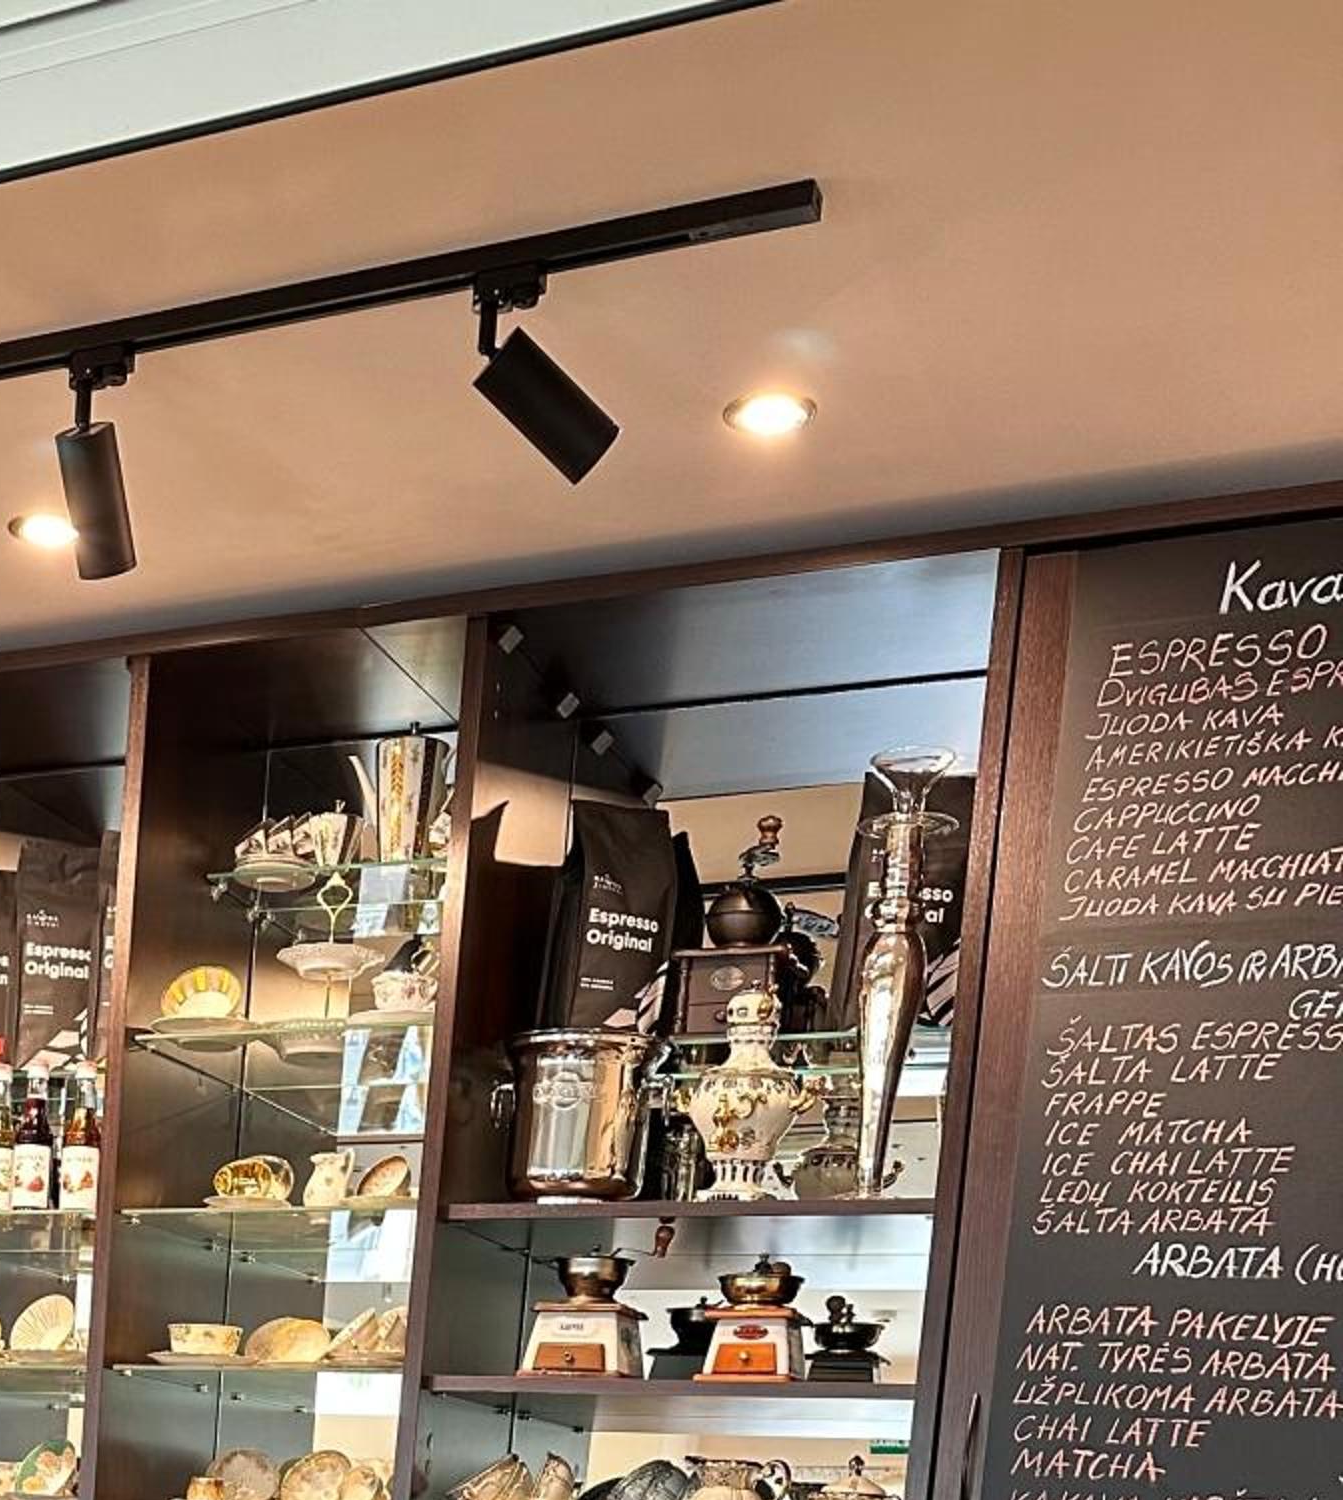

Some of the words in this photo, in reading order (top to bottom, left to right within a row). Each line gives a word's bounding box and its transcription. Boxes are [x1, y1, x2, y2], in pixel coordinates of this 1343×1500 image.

[1108, 624, 1327, 678] ESPRESSO
[1085, 711, 1194, 740] JUODA
[1203, 703, 1284, 730] KAVA
[1085, 727, 1312, 772] AMERIKIETIŠKA
[1082, 768, 1233, 803] ESPRESSO
[1073, 795, 1261, 833] CAPPUCCINO
[1066, 834, 1145, 865] CAFE
[1152, 823, 1262, 855] LATTE
[1064, 858, 1198, 894] CARAMEL
[588, 907, 659, 934] Espresso
[1059, 895, 1159, 921] JUODA
[1168, 890, 1237, 917] KAVA
[1246, 885, 1287, 911] SU
[586, 928, 653, 953] Original
[24, 960, 90, 980] Original
[1041, 946, 1134, 988] ŠALTI
[1138, 939, 1234, 988] KAVOS
[1047, 1016, 1180, 1057] ŠALTAS
[1041, 1052, 1153, 1088] ŠALTA
[1170, 1053, 1283, 1084] LATTE
[1044, 1091, 1168, 1119] FRAPPE
[1044, 1120, 1101, 1147] ICE
[1118, 1117, 1254, 1147] MATCHA
[1042, 1151, 1094, 1177] ICE
[1110, 1149, 1180, 1177] CHAI
[1187, 1146, 1296, 1178] LATTE
[1040, 1179, 1112, 1210] LEDŲ
[1128, 1176, 1278, 1207] KOKTEILIS
[1033, 1202, 1136, 1236] ŠALTA
[1138, 1207, 1278, 1237] ARBATA
[1131, 1241, 1285, 1279] ARBATA
[1025, 1304, 1159, 1338] ARBATA
[1168, 1308, 1336, 1349] PAKELYJE
[1016, 1341, 1085, 1373] NAT.
[1200, 1349, 1337, 1383] ARBATA
[1012, 1375, 1196, 1414] UŽPLIKOMA
[1203, 1386, 1343, 1420] ARBATA
[1013, 1412, 1092, 1443] CHAI
[1105, 1417, 1212, 1448] LATTE
[1010, 1448, 1166, 1483] MATCHA
